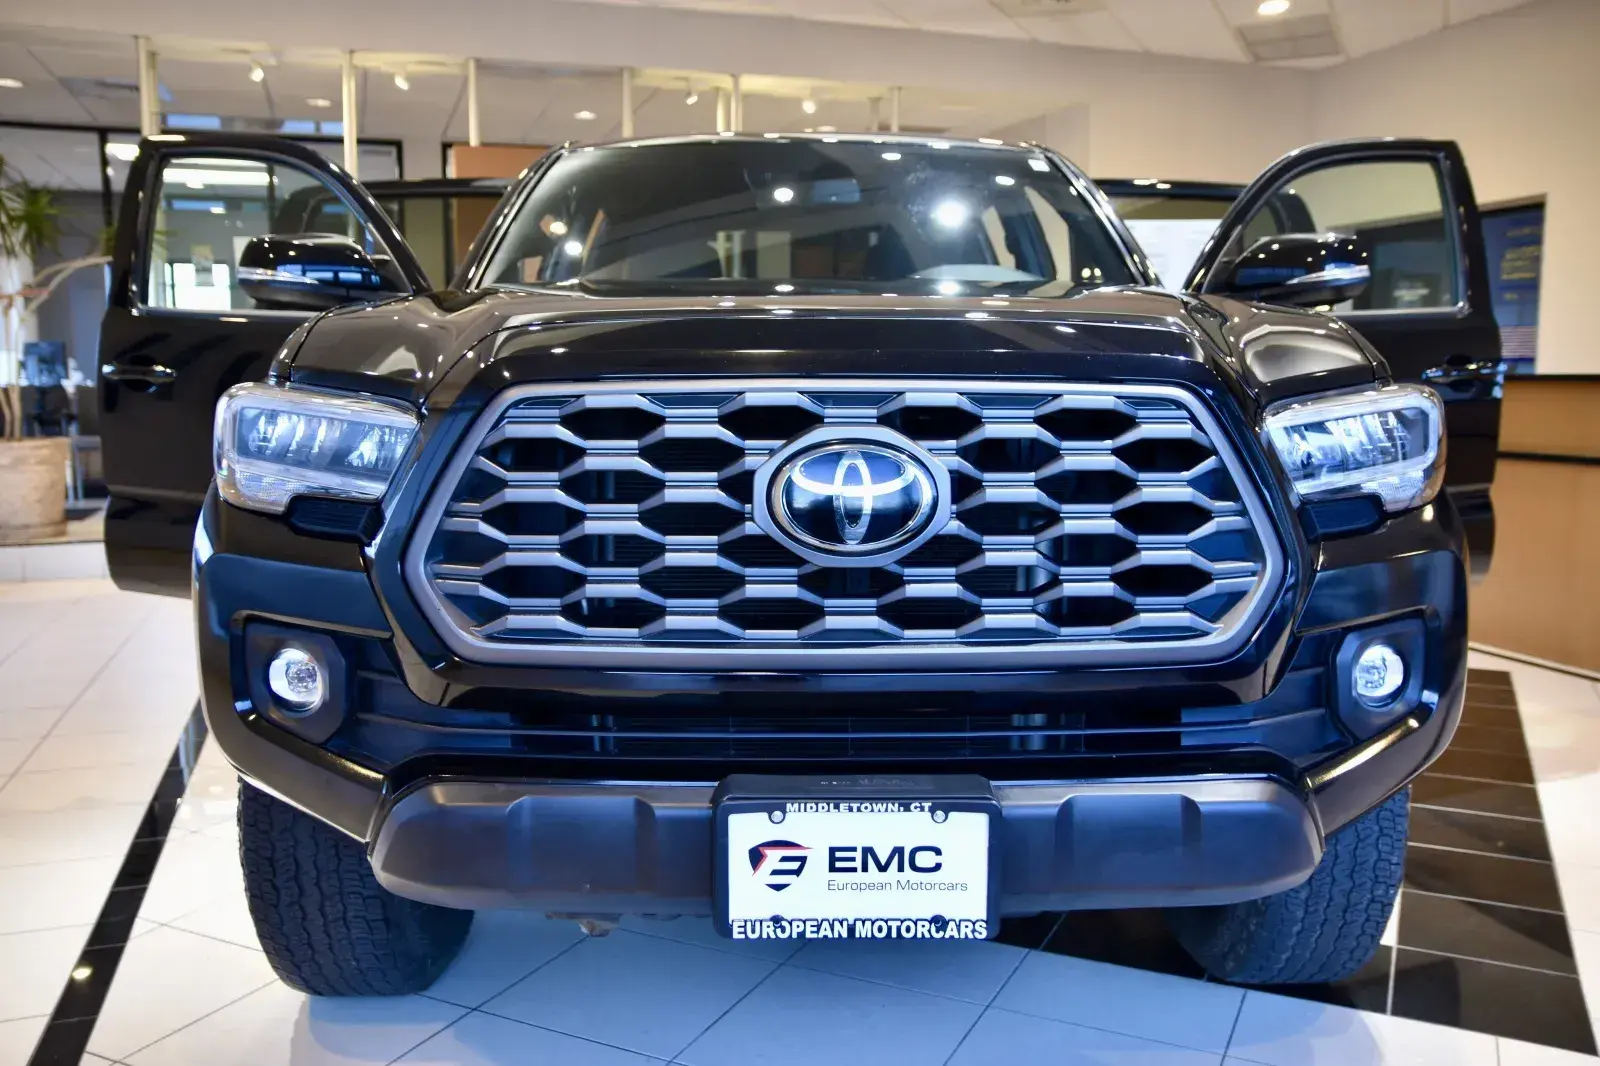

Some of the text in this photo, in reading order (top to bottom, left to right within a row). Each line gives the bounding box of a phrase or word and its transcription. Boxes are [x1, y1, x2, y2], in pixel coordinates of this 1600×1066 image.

[785, 802, 932, 813] MIDDLETOWN, CT
[828, 845, 943, 874] EMC
[827, 879, 969, 893] European Motorcars
[732, 919, 988, 940] EUROPEAN MOTORCARS
